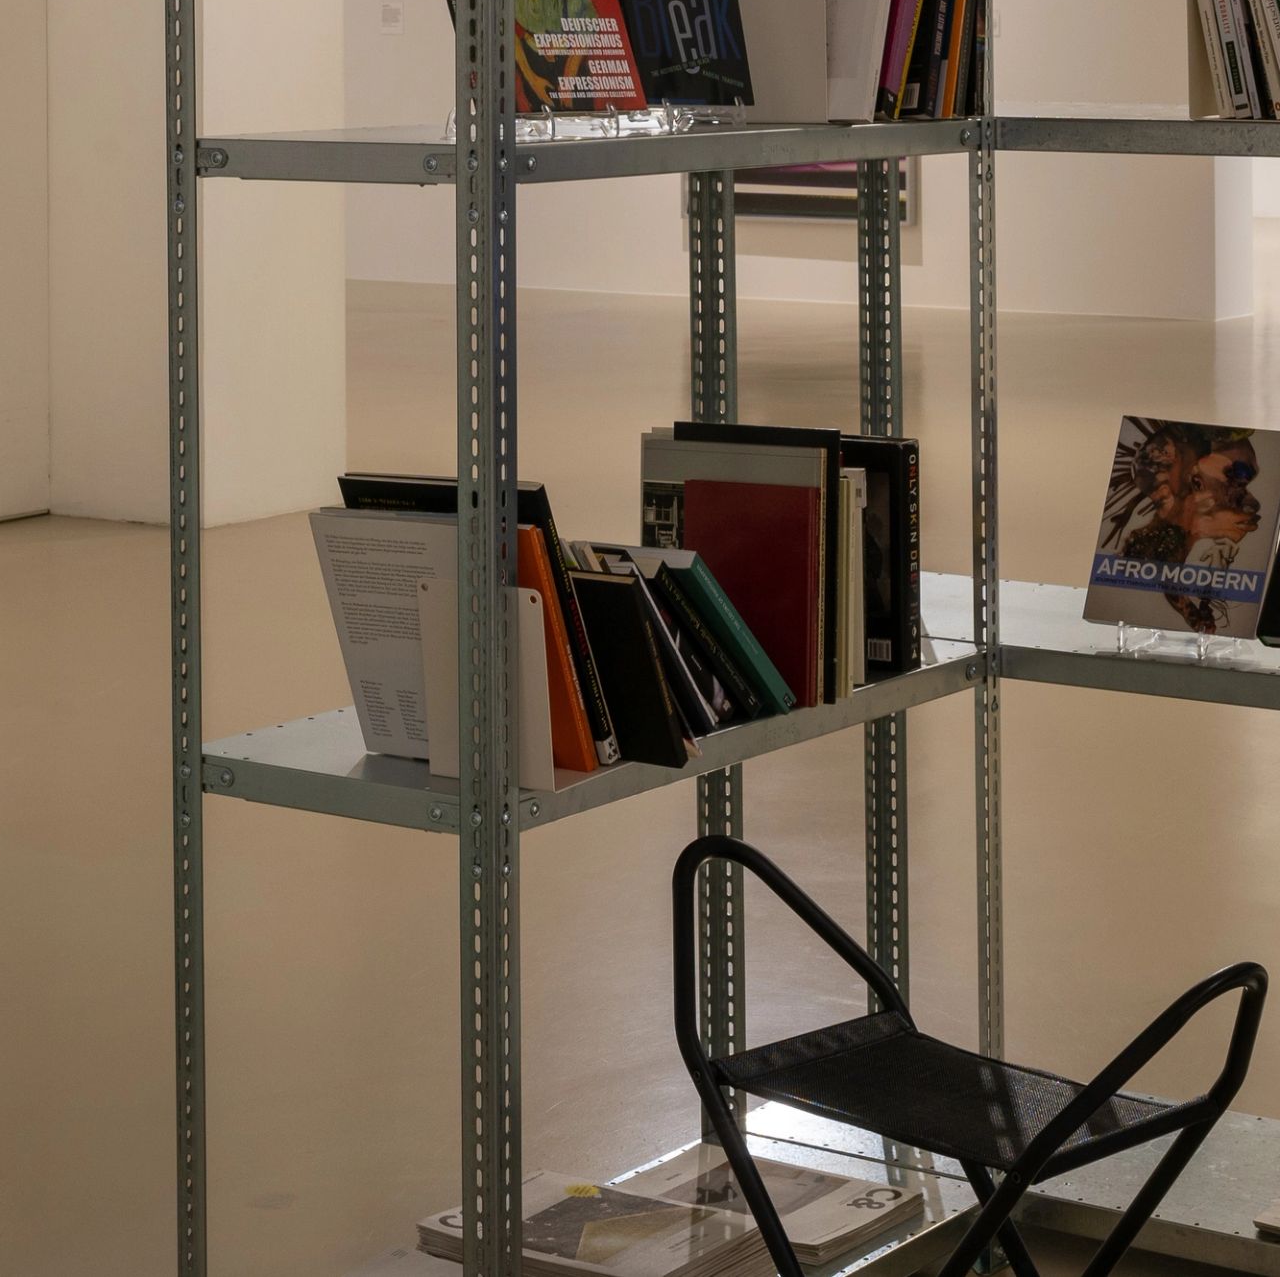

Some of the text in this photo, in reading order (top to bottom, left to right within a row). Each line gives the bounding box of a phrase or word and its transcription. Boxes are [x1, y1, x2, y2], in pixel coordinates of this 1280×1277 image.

[939, 1, 948, 13] AND
[560, 17, 619, 32] DEUTSCHER
[937, 14, 946, 31] LATIN
[534, 33, 623, 48] EXPRESSIONISMUS
[934, 33, 944, 56] AMERICA
[588, 60, 630, 74] GERMAN
[558, 76, 634, 90] EXPRESSIONISM
[908, 454, 916, 496] ONLY
[909, 502, 917, 543] SKIN
[909, 549, 918, 594] DEEP
[1097, 558, 1258, 592] AFRO MODERN
